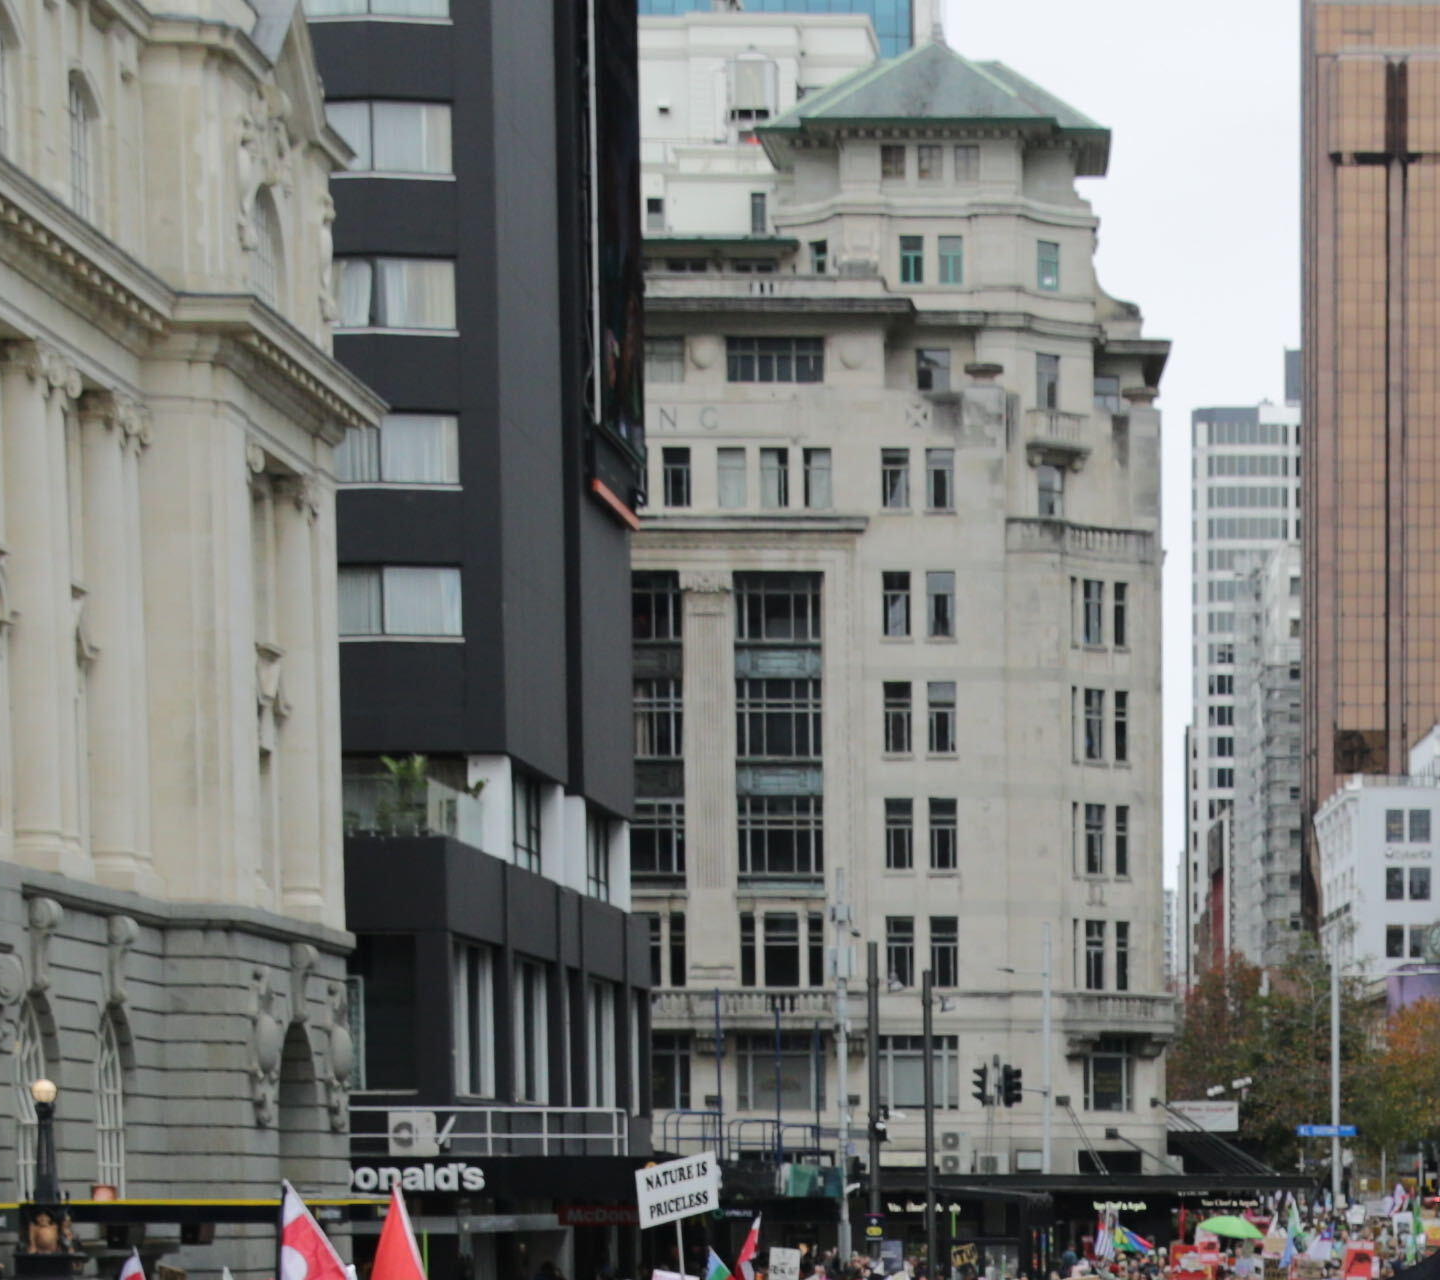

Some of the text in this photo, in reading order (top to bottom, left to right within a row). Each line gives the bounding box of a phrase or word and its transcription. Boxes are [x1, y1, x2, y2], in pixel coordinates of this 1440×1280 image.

[646, 1162, 709, 1191] NATURE IS
[649, 1190, 709, 1218] PRICELESS
